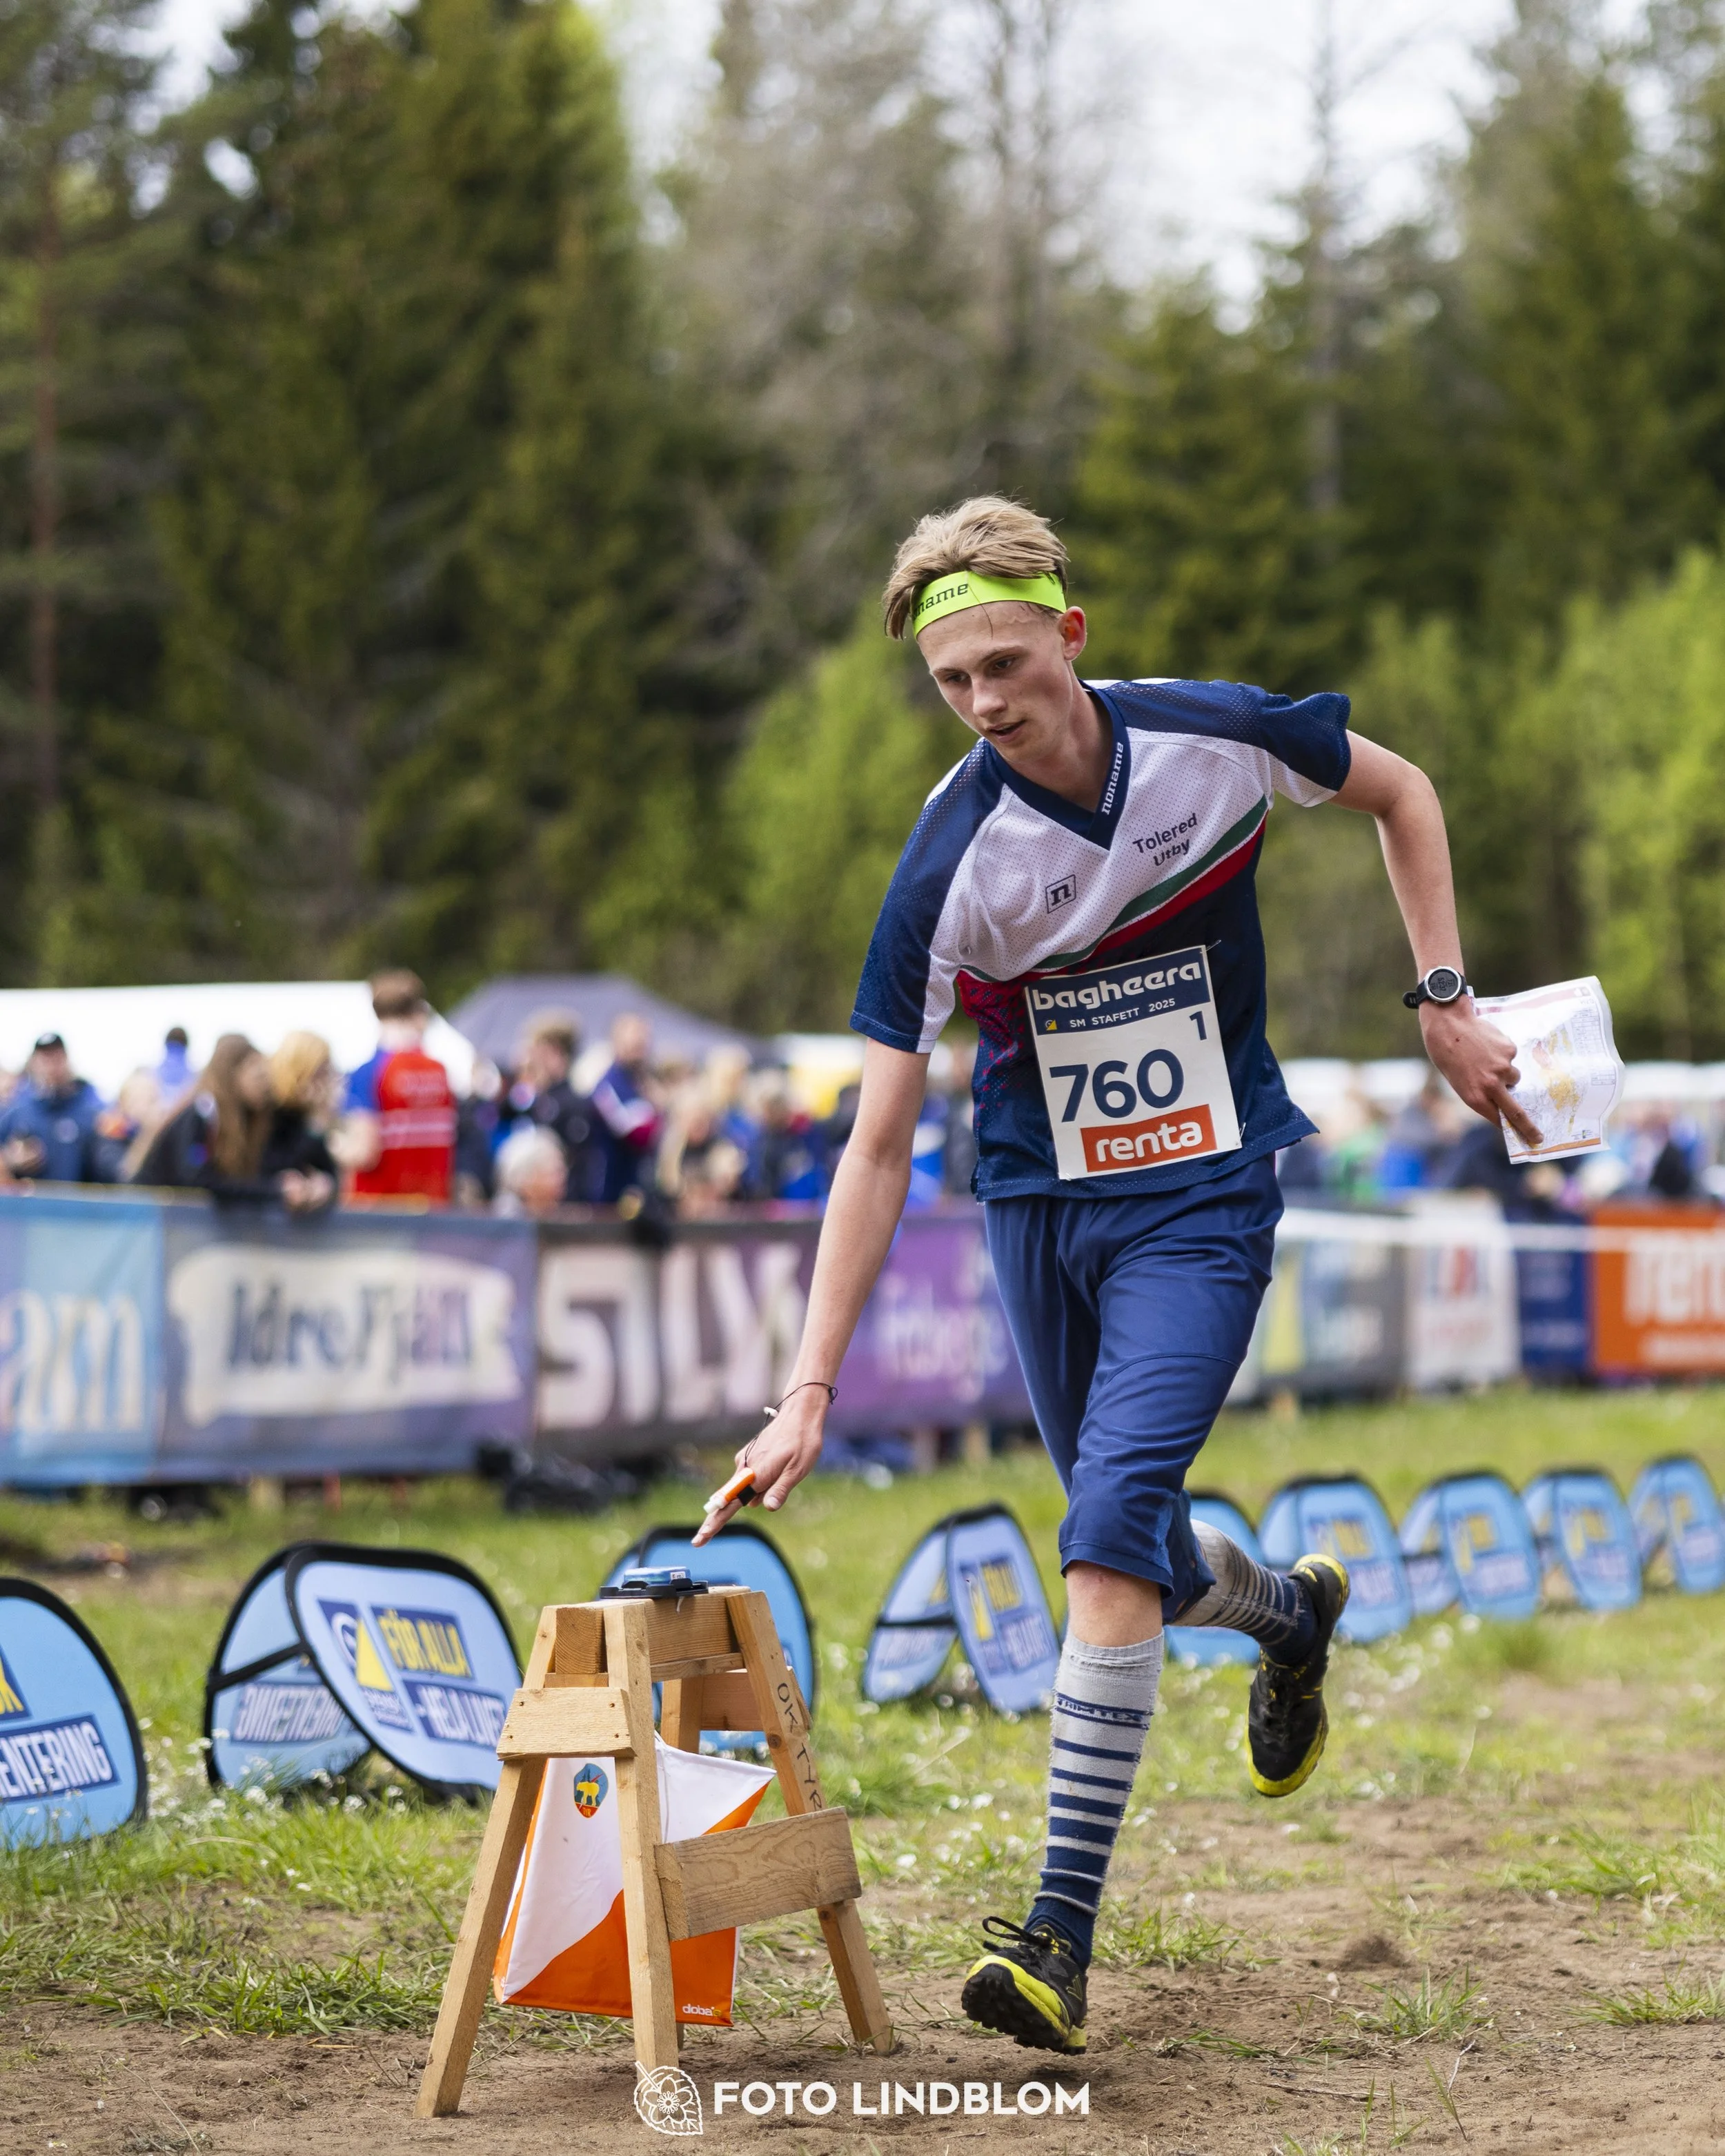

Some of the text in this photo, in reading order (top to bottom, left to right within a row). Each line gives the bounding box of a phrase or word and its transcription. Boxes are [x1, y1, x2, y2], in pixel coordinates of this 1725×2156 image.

[1101, 742, 1123, 815] noname
[1132, 813, 1198, 854] Tolered
[1153, 839, 1191, 867] Utby
[1034, 962, 1202, 1010] bagheera
[1070, 998, 1176, 1029] SM STAFETT 2025
[1189, 1011, 1208, 1041] 1
[1048, 1049, 1185, 1123] 760
[1094, 1120, 1203, 1163] renta
[777, 1683, 822, 1812] OK TYR
